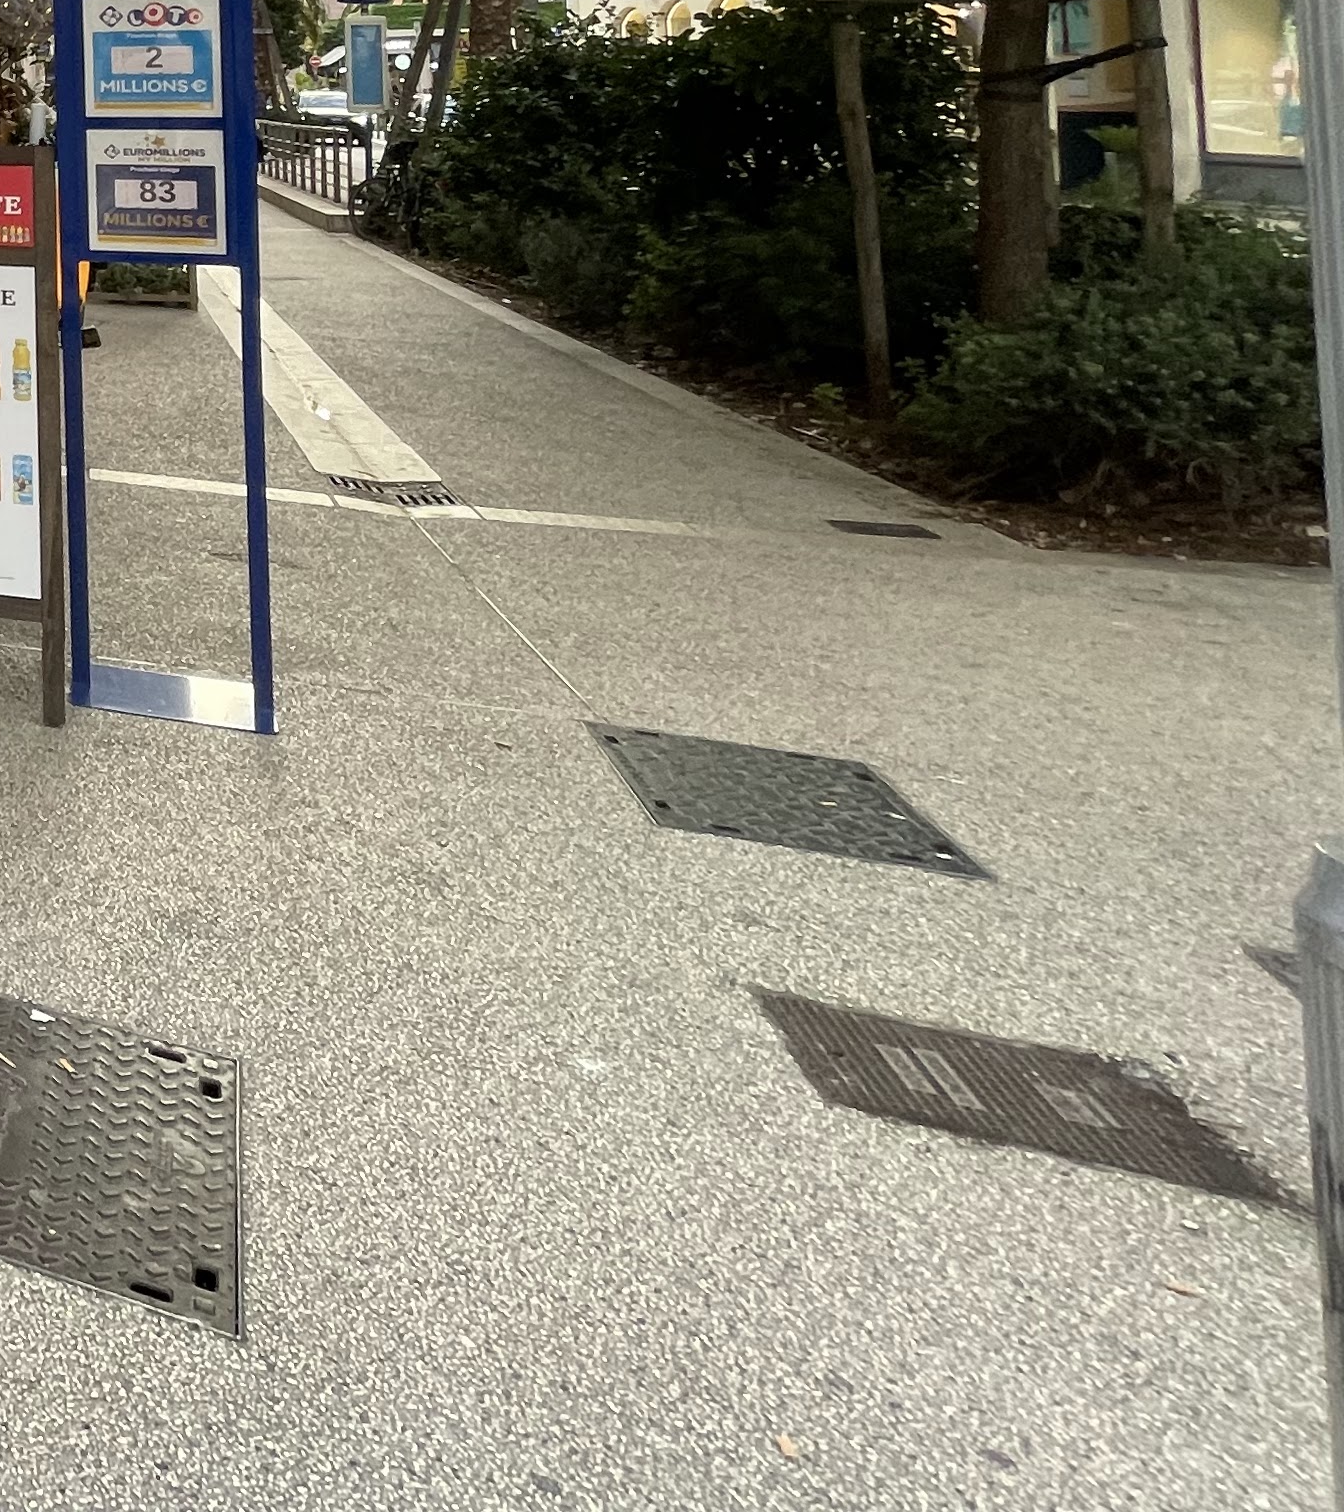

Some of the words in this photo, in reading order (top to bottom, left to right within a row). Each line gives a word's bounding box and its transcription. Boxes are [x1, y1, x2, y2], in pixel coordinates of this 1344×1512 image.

[126, 2, 204, 27] LOTO
[144, 46, 164, 69] 2
[99, 79, 189, 94] MILLIONS
[190, 78, 208, 93] €
[122, 147, 206, 158] EUROMILLIONS
[139, 180, 177, 203] 83
[102, 212, 194, 228] MILLIONS
[196, 214, 210, 228] €
